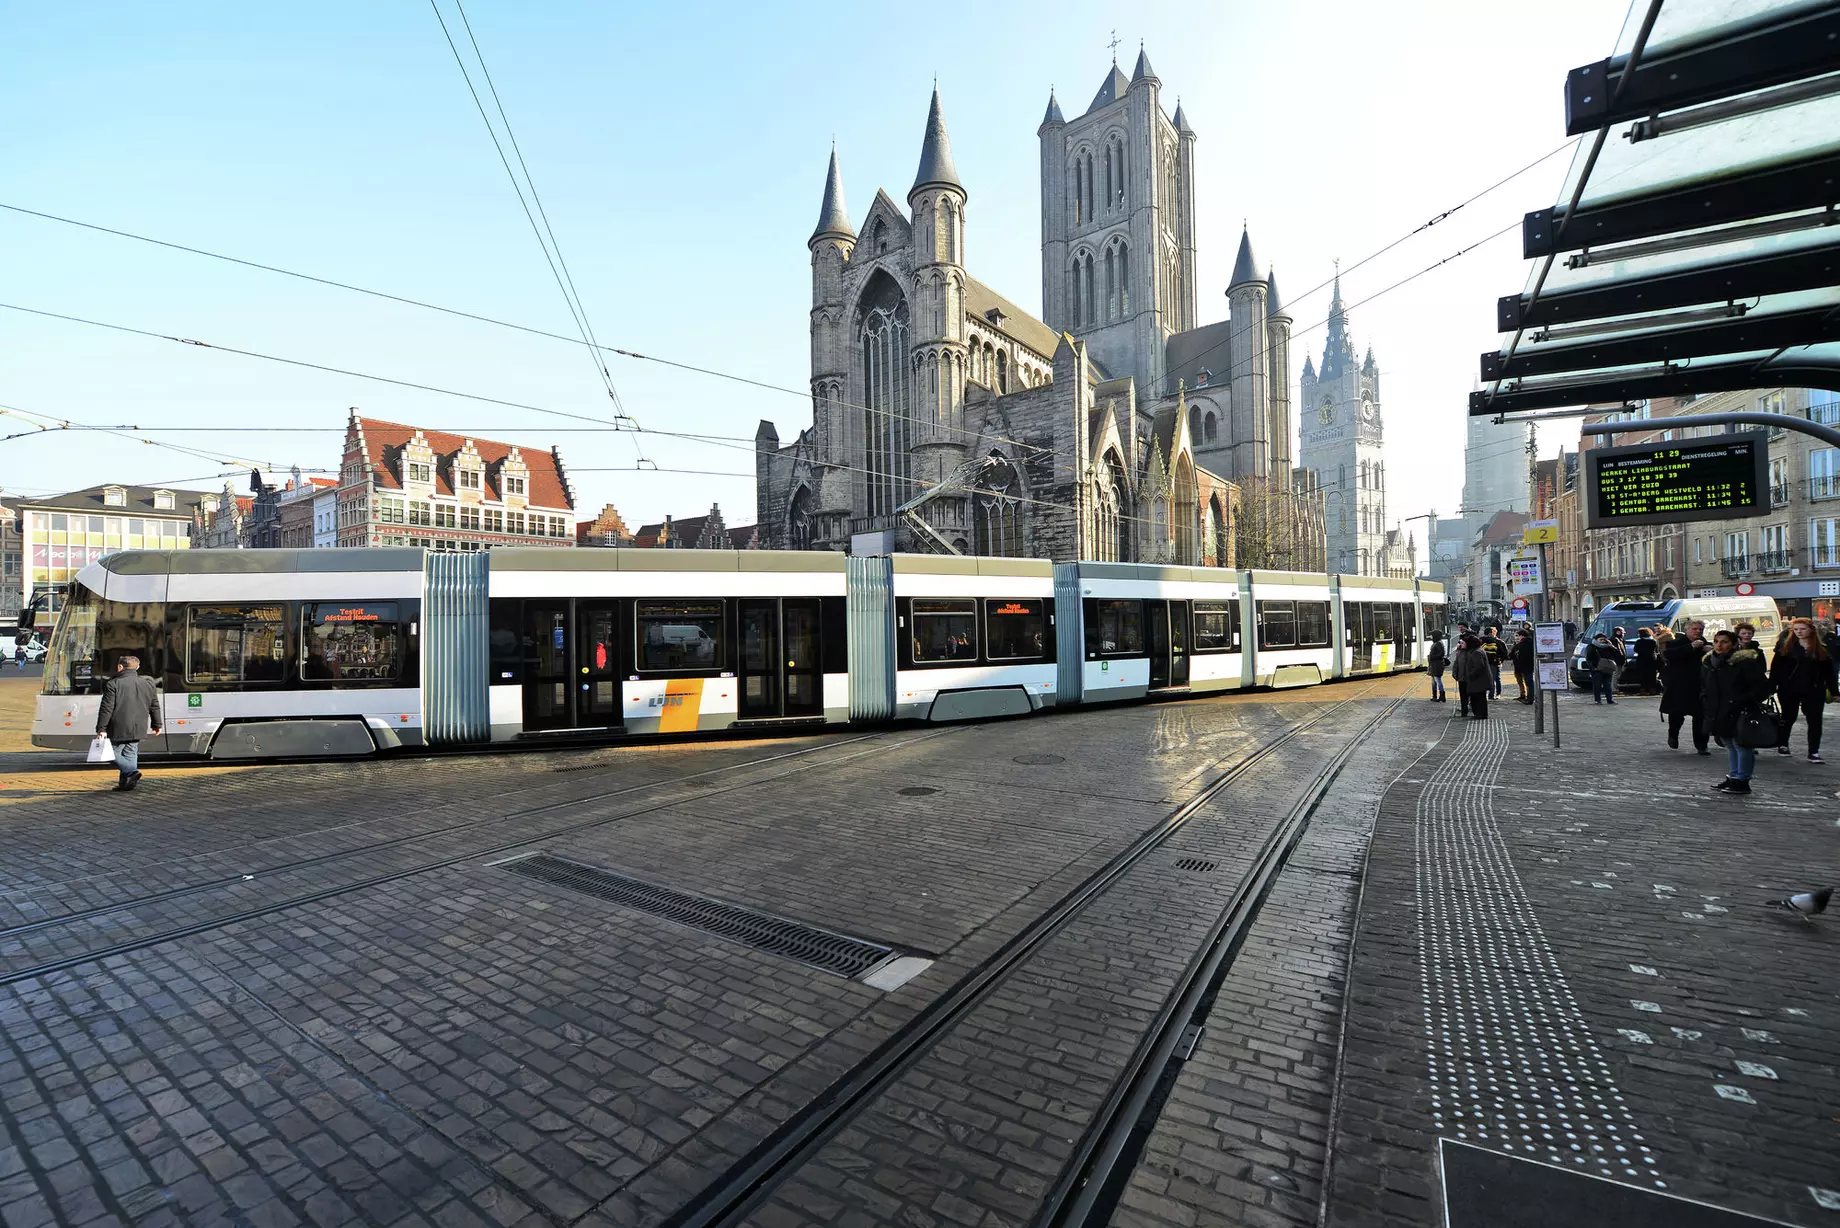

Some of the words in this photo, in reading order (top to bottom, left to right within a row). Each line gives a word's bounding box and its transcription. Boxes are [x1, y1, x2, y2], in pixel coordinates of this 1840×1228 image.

[1617, 458, 1653, 467] BESTEMMING
[1681, 450, 1728, 461] DIENSTREGELING
[1600, 469, 1628, 477] WERKEN
[1539, 529, 1549, 540] 2
